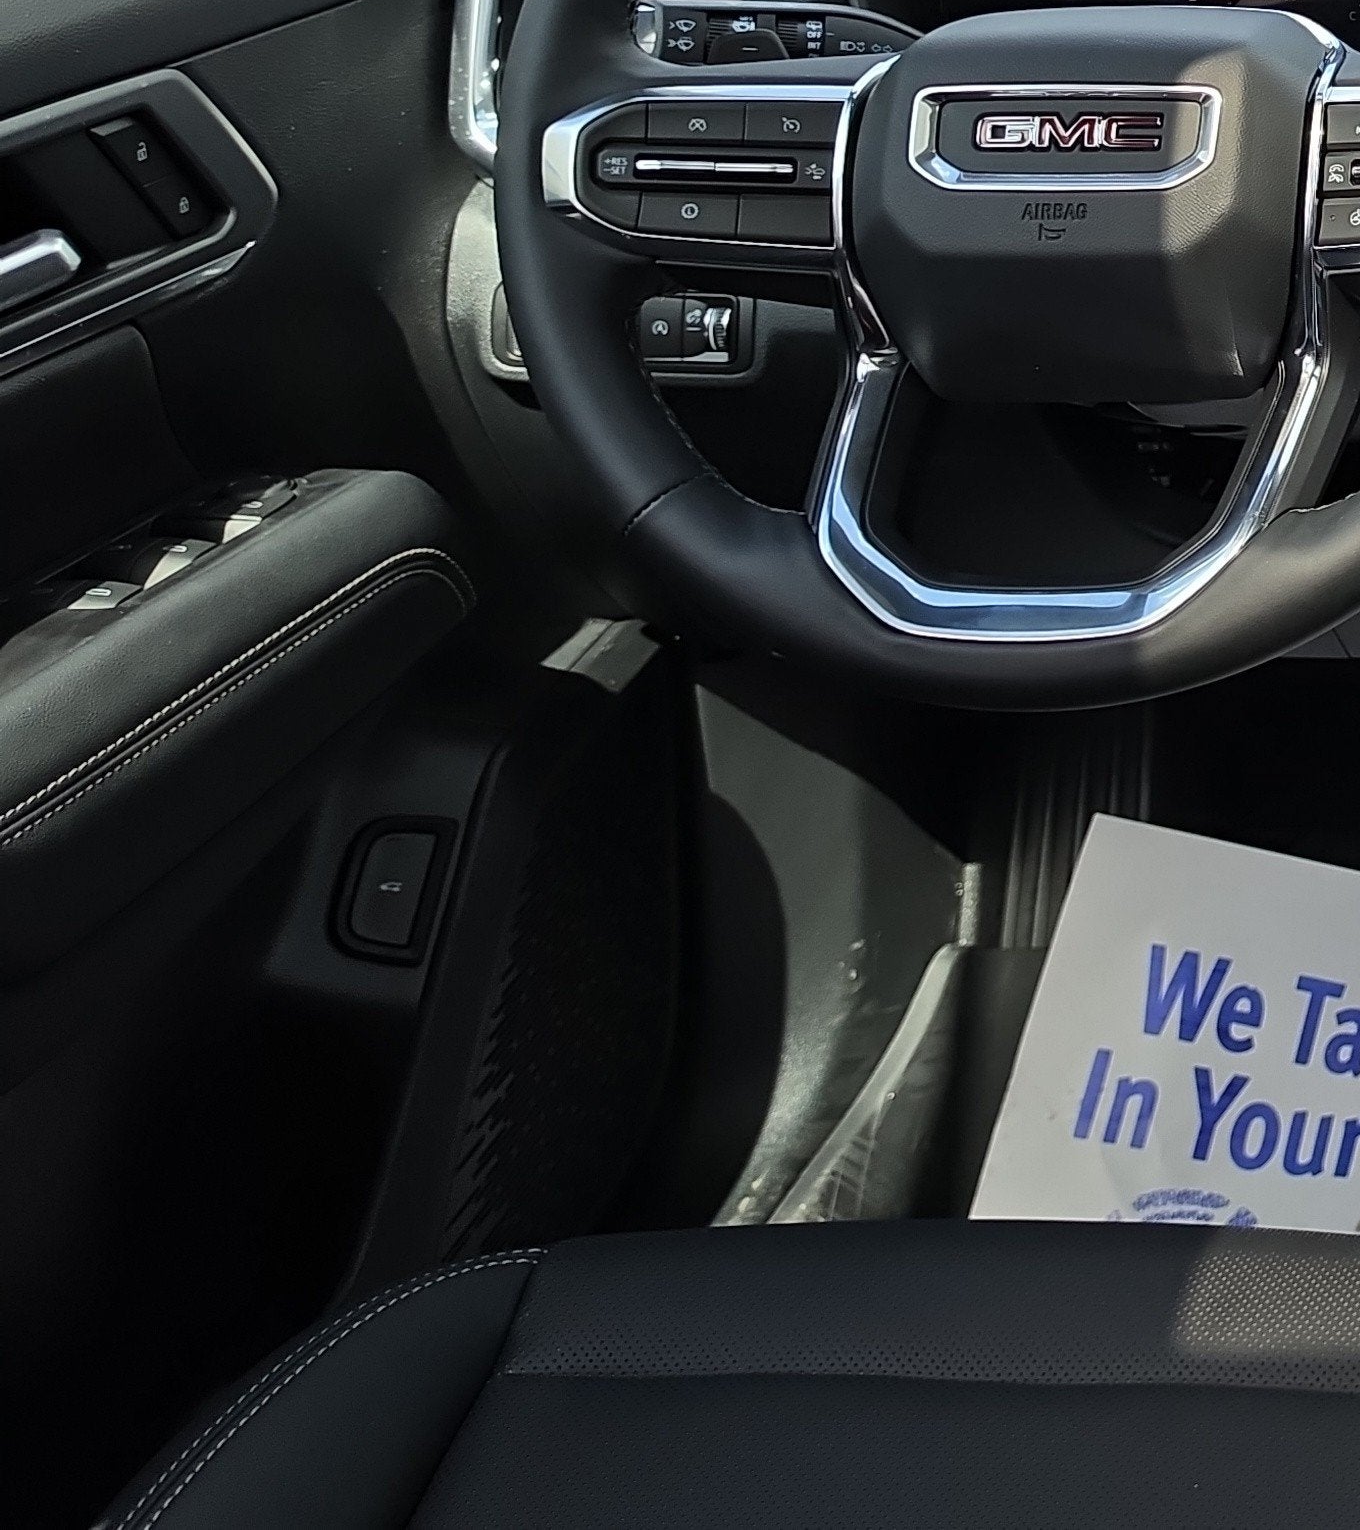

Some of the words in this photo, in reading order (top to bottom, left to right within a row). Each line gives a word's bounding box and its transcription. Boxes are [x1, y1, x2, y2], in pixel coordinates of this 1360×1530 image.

[976, 115, 1162, 148] GMC
[1022, 203, 1088, 220] AIRBAG
[1143, 943, 1266, 1054] We
[1073, 1046, 1162, 1150] In
